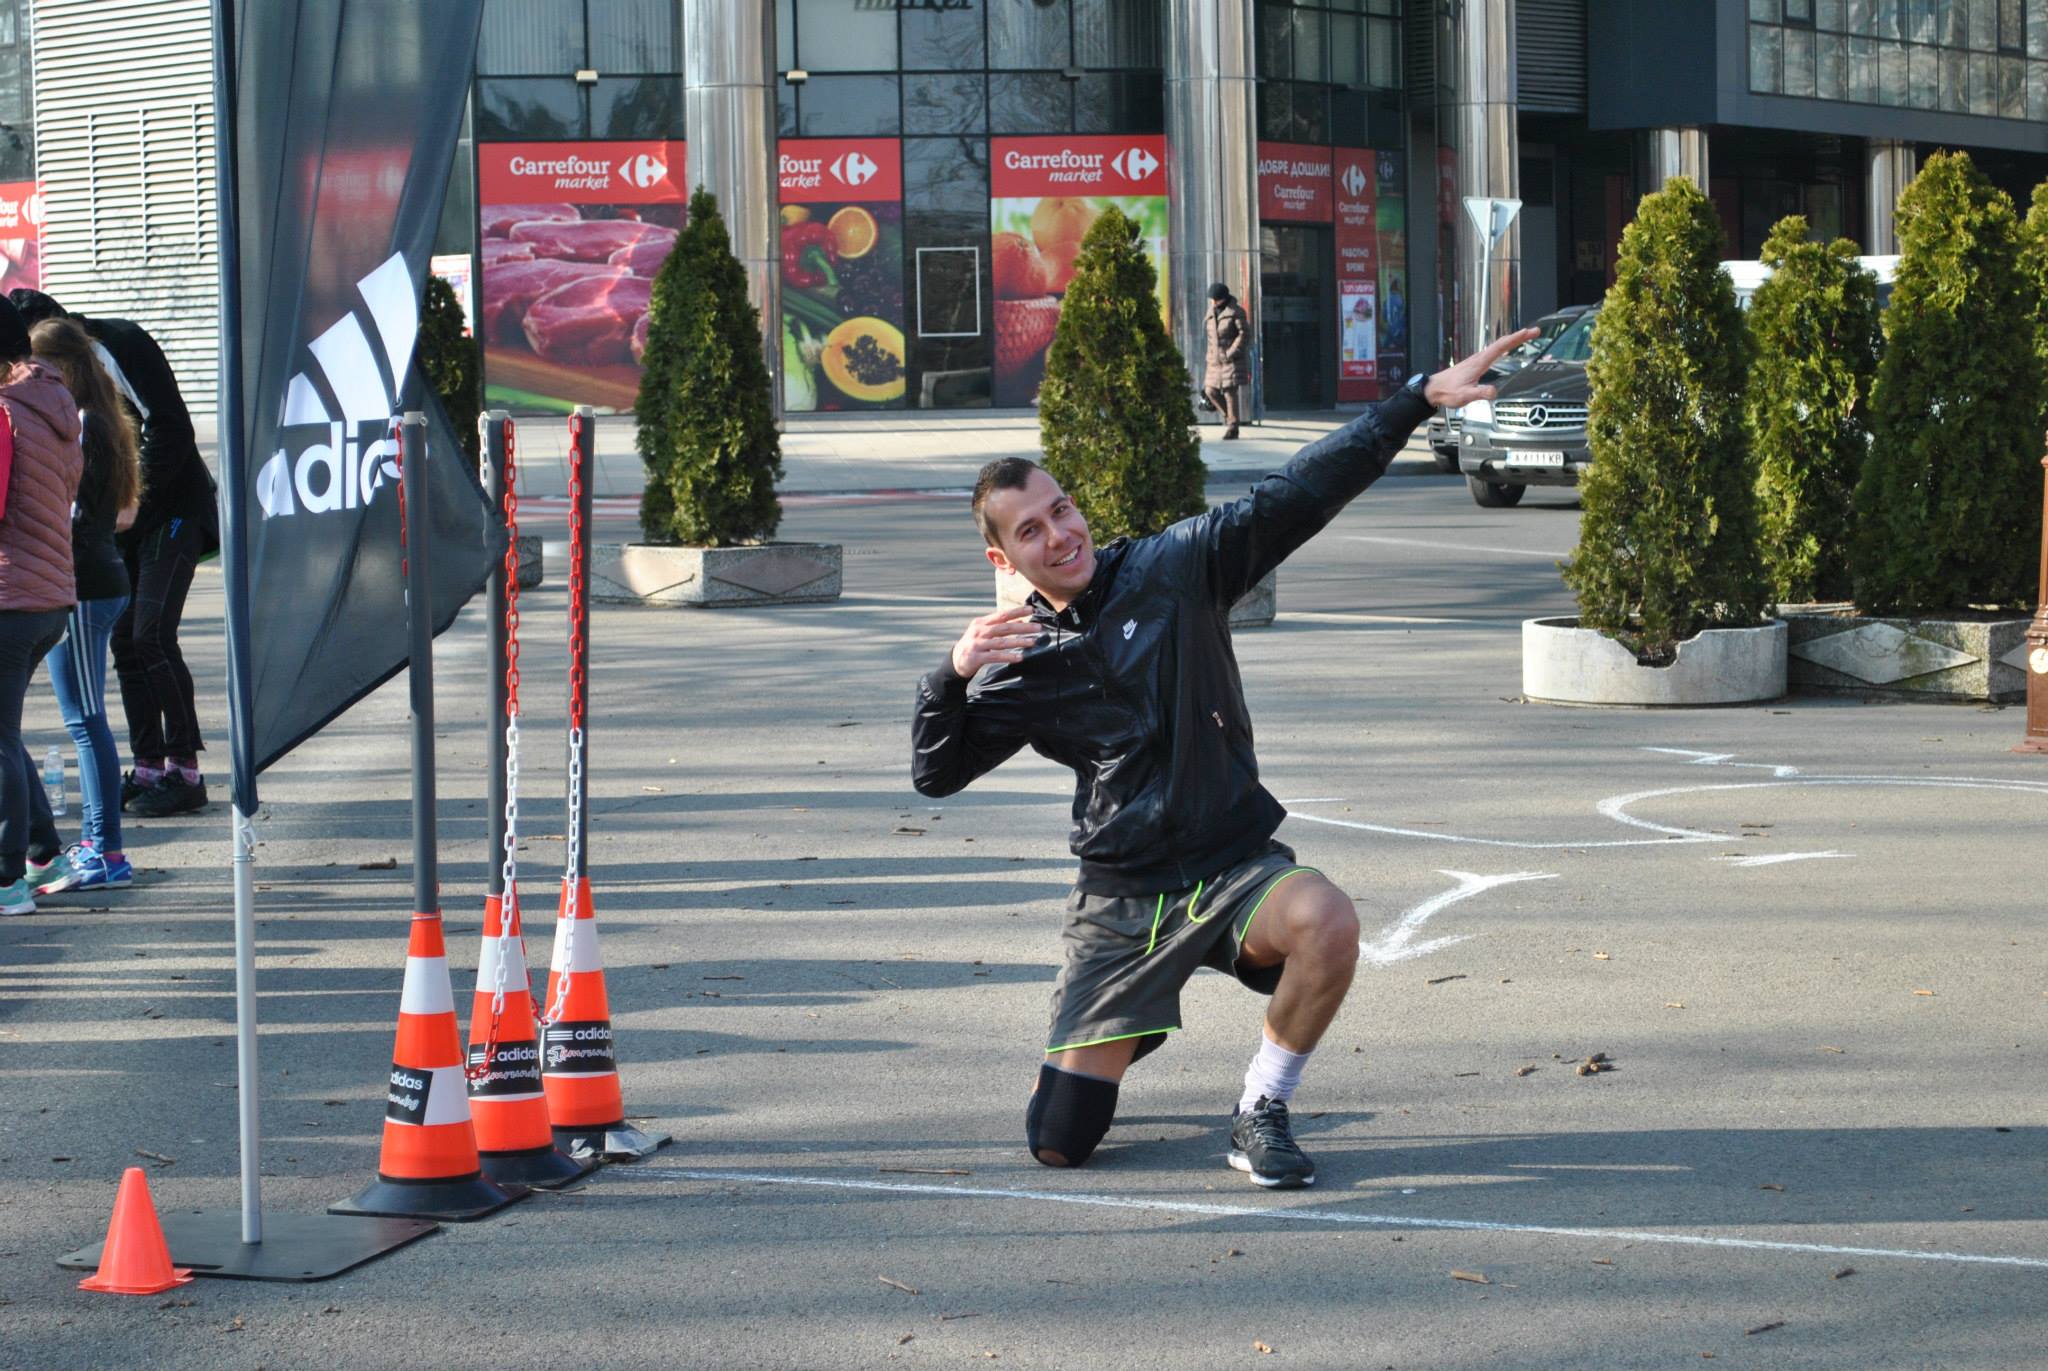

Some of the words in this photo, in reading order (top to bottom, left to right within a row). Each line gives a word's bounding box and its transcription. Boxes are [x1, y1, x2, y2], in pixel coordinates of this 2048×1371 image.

[509, 154, 611, 176] Carrefour
[1004, 149, 1104, 170] Carrefour
[1258, 159, 1289, 176] ДОБРЕ
[554, 174, 610, 191] market
[780, 173, 821, 189] arket
[1049, 168, 1103, 184] market
[1273, 184, 1315, 201] Carrefour
[390, 1071, 424, 1091] didas
